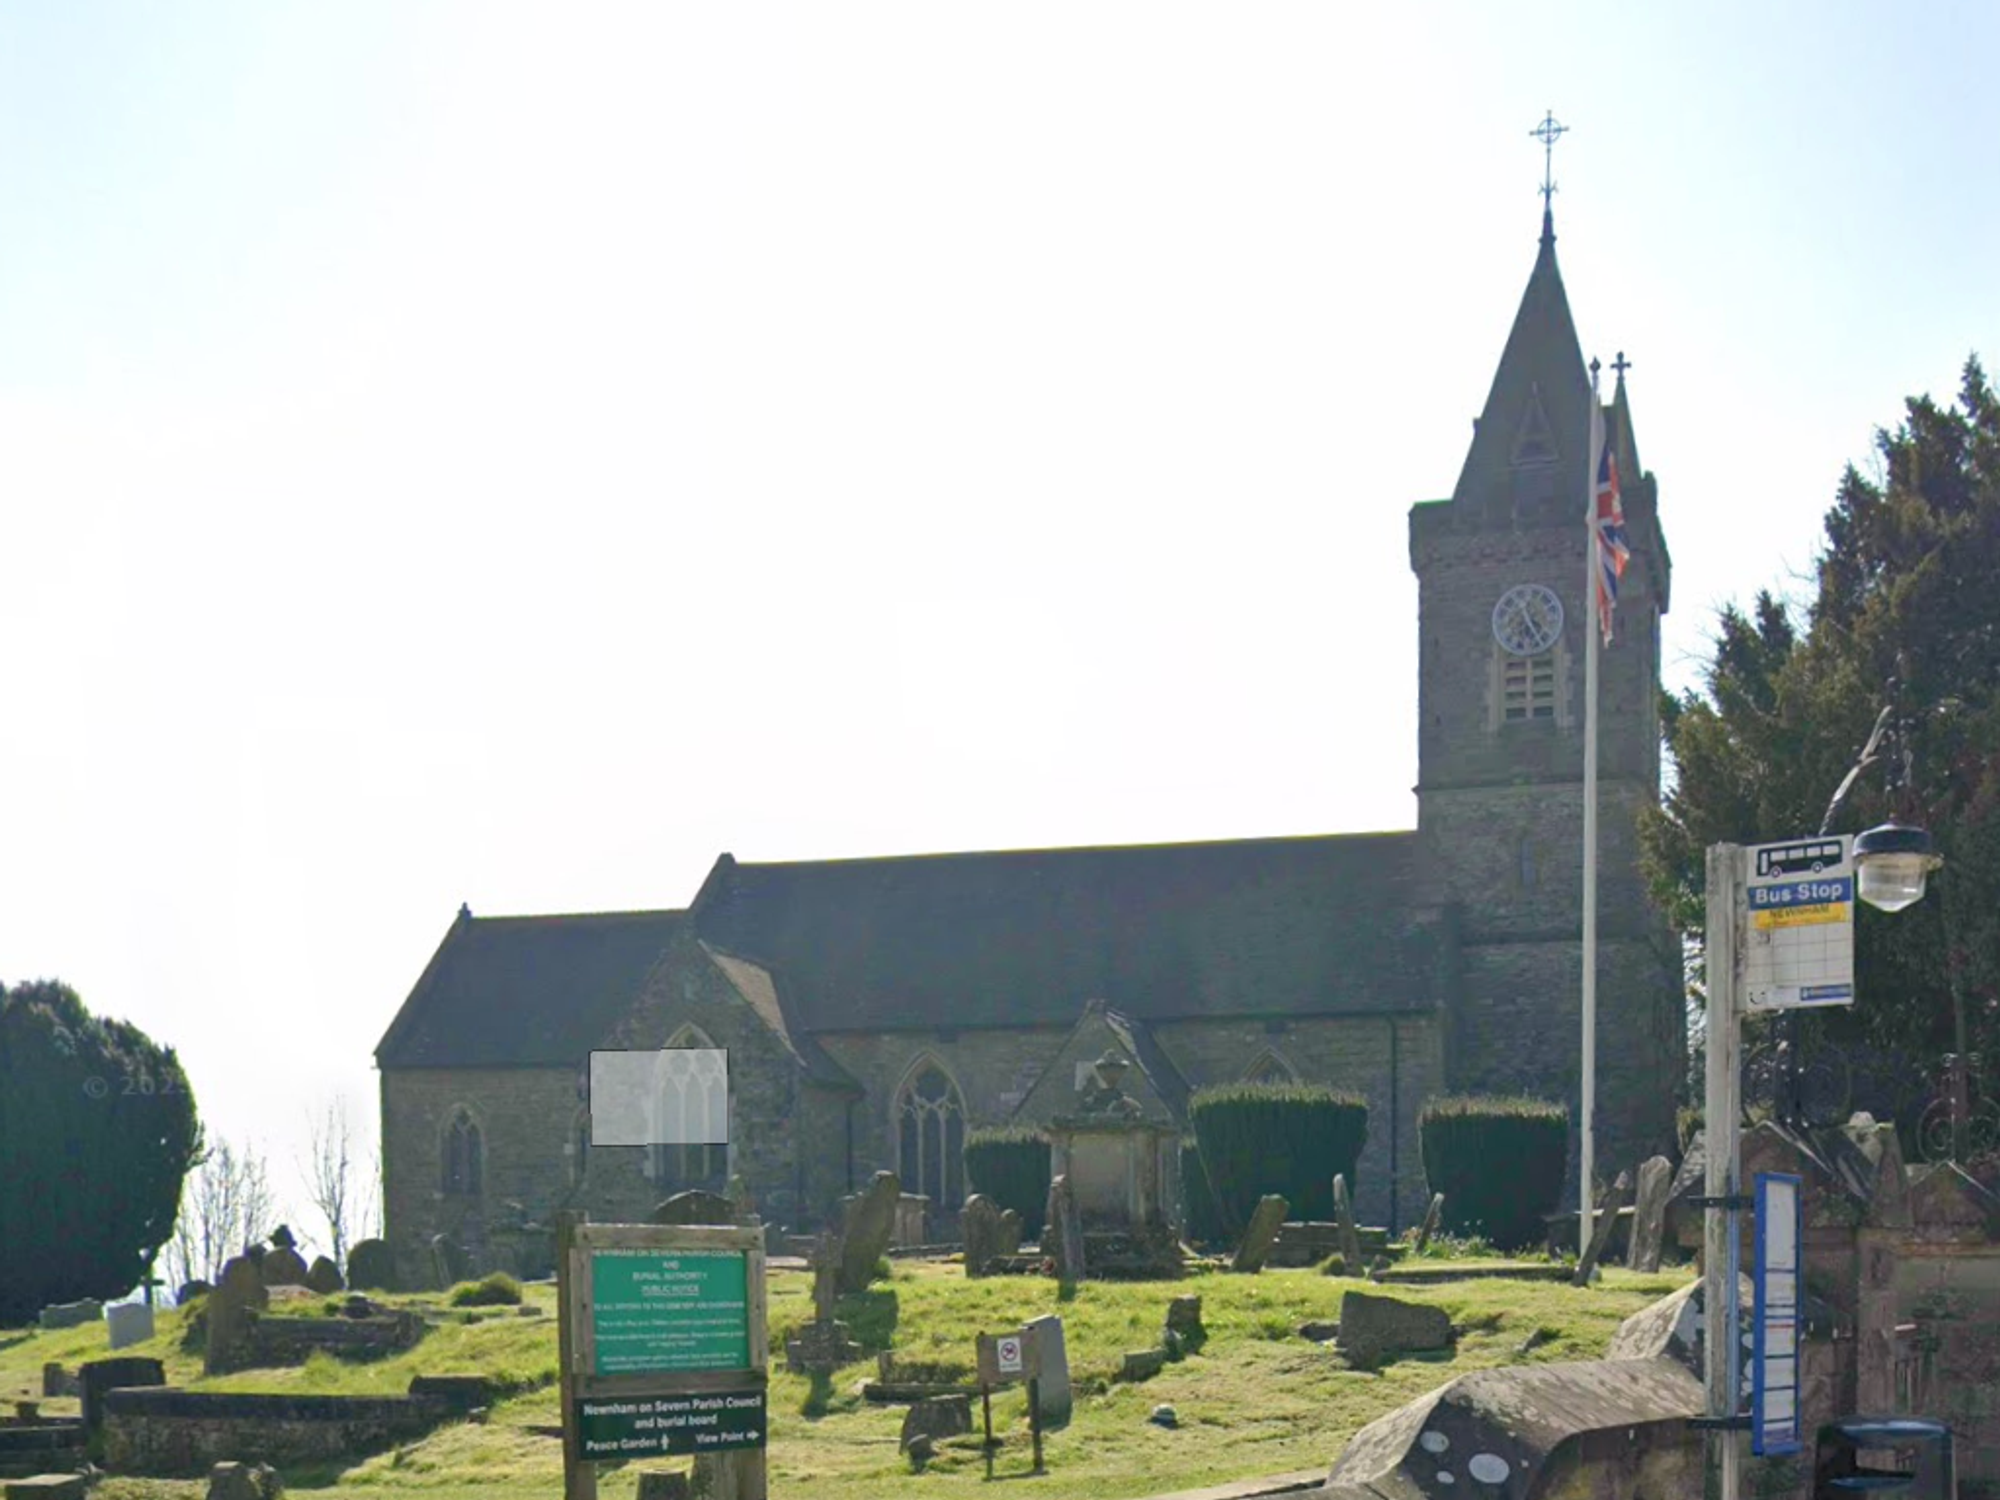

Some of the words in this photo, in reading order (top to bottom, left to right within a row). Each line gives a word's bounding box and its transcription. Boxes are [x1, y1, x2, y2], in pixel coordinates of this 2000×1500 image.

[1755, 888, 1792, 904] Bus
[1797, 883, 1844, 899] Stop
[583, 1401, 637, 1417] Newnham
[639, 1403, 653, 1413] on
[654, 1399, 690, 1412] Severn
[693, 1397, 723, 1410] Parish
[725, 1395, 761, 1408] Council
[634, 1415, 655, 1429] and
[656, 1414, 687, 1428] burial
[688, 1413, 718, 1426] board
[586, 1440, 618, 1452] Peace
[620, 1436, 657, 1449] Garden
[695, 1432, 719, 1445] View
[720, 1430, 744, 1443] Point
